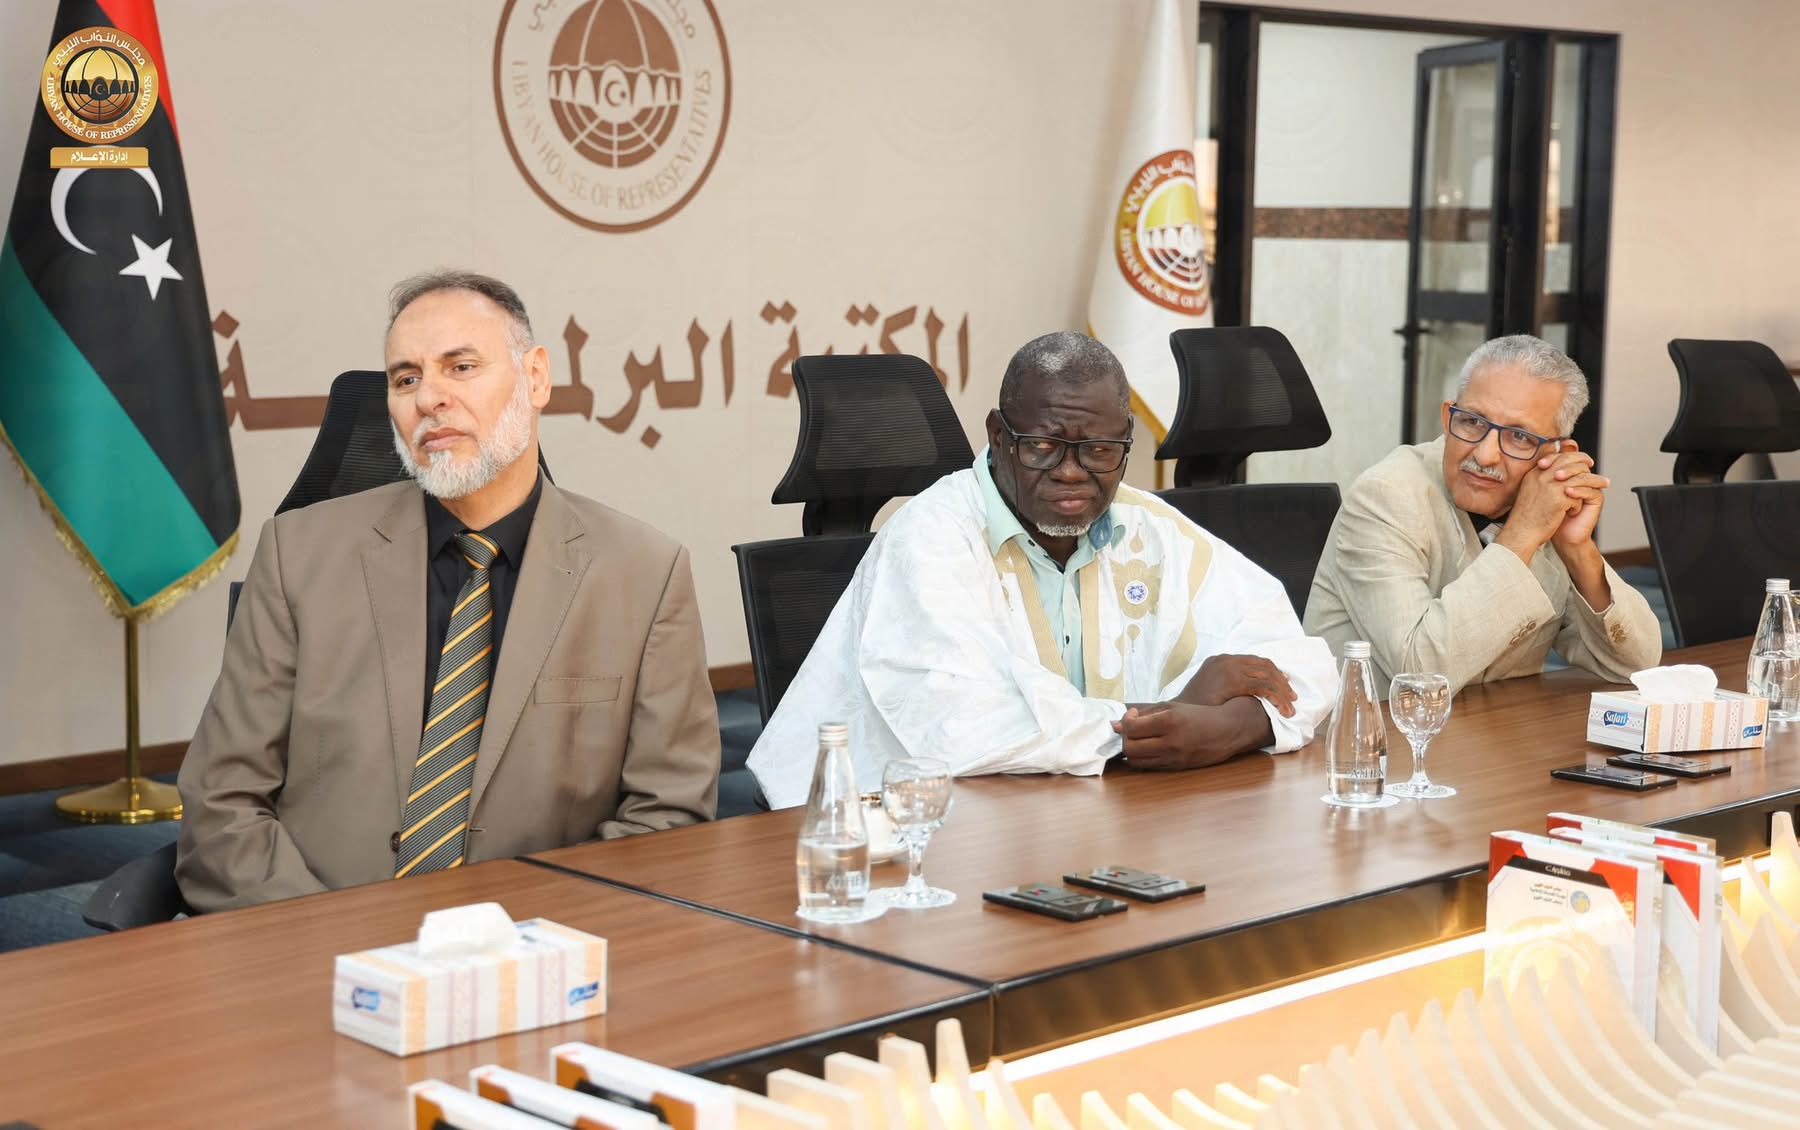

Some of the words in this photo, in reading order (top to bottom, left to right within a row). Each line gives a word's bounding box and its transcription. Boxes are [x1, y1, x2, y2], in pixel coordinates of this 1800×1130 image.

[511, 59, 544, 145] LIBYAN
[538, 142, 590, 198] HOUSE
[591, 182, 611, 208] OF
[617, 69, 712, 210] REPRESENTATIVES
[1604, 711, 1628, 725] Safari
